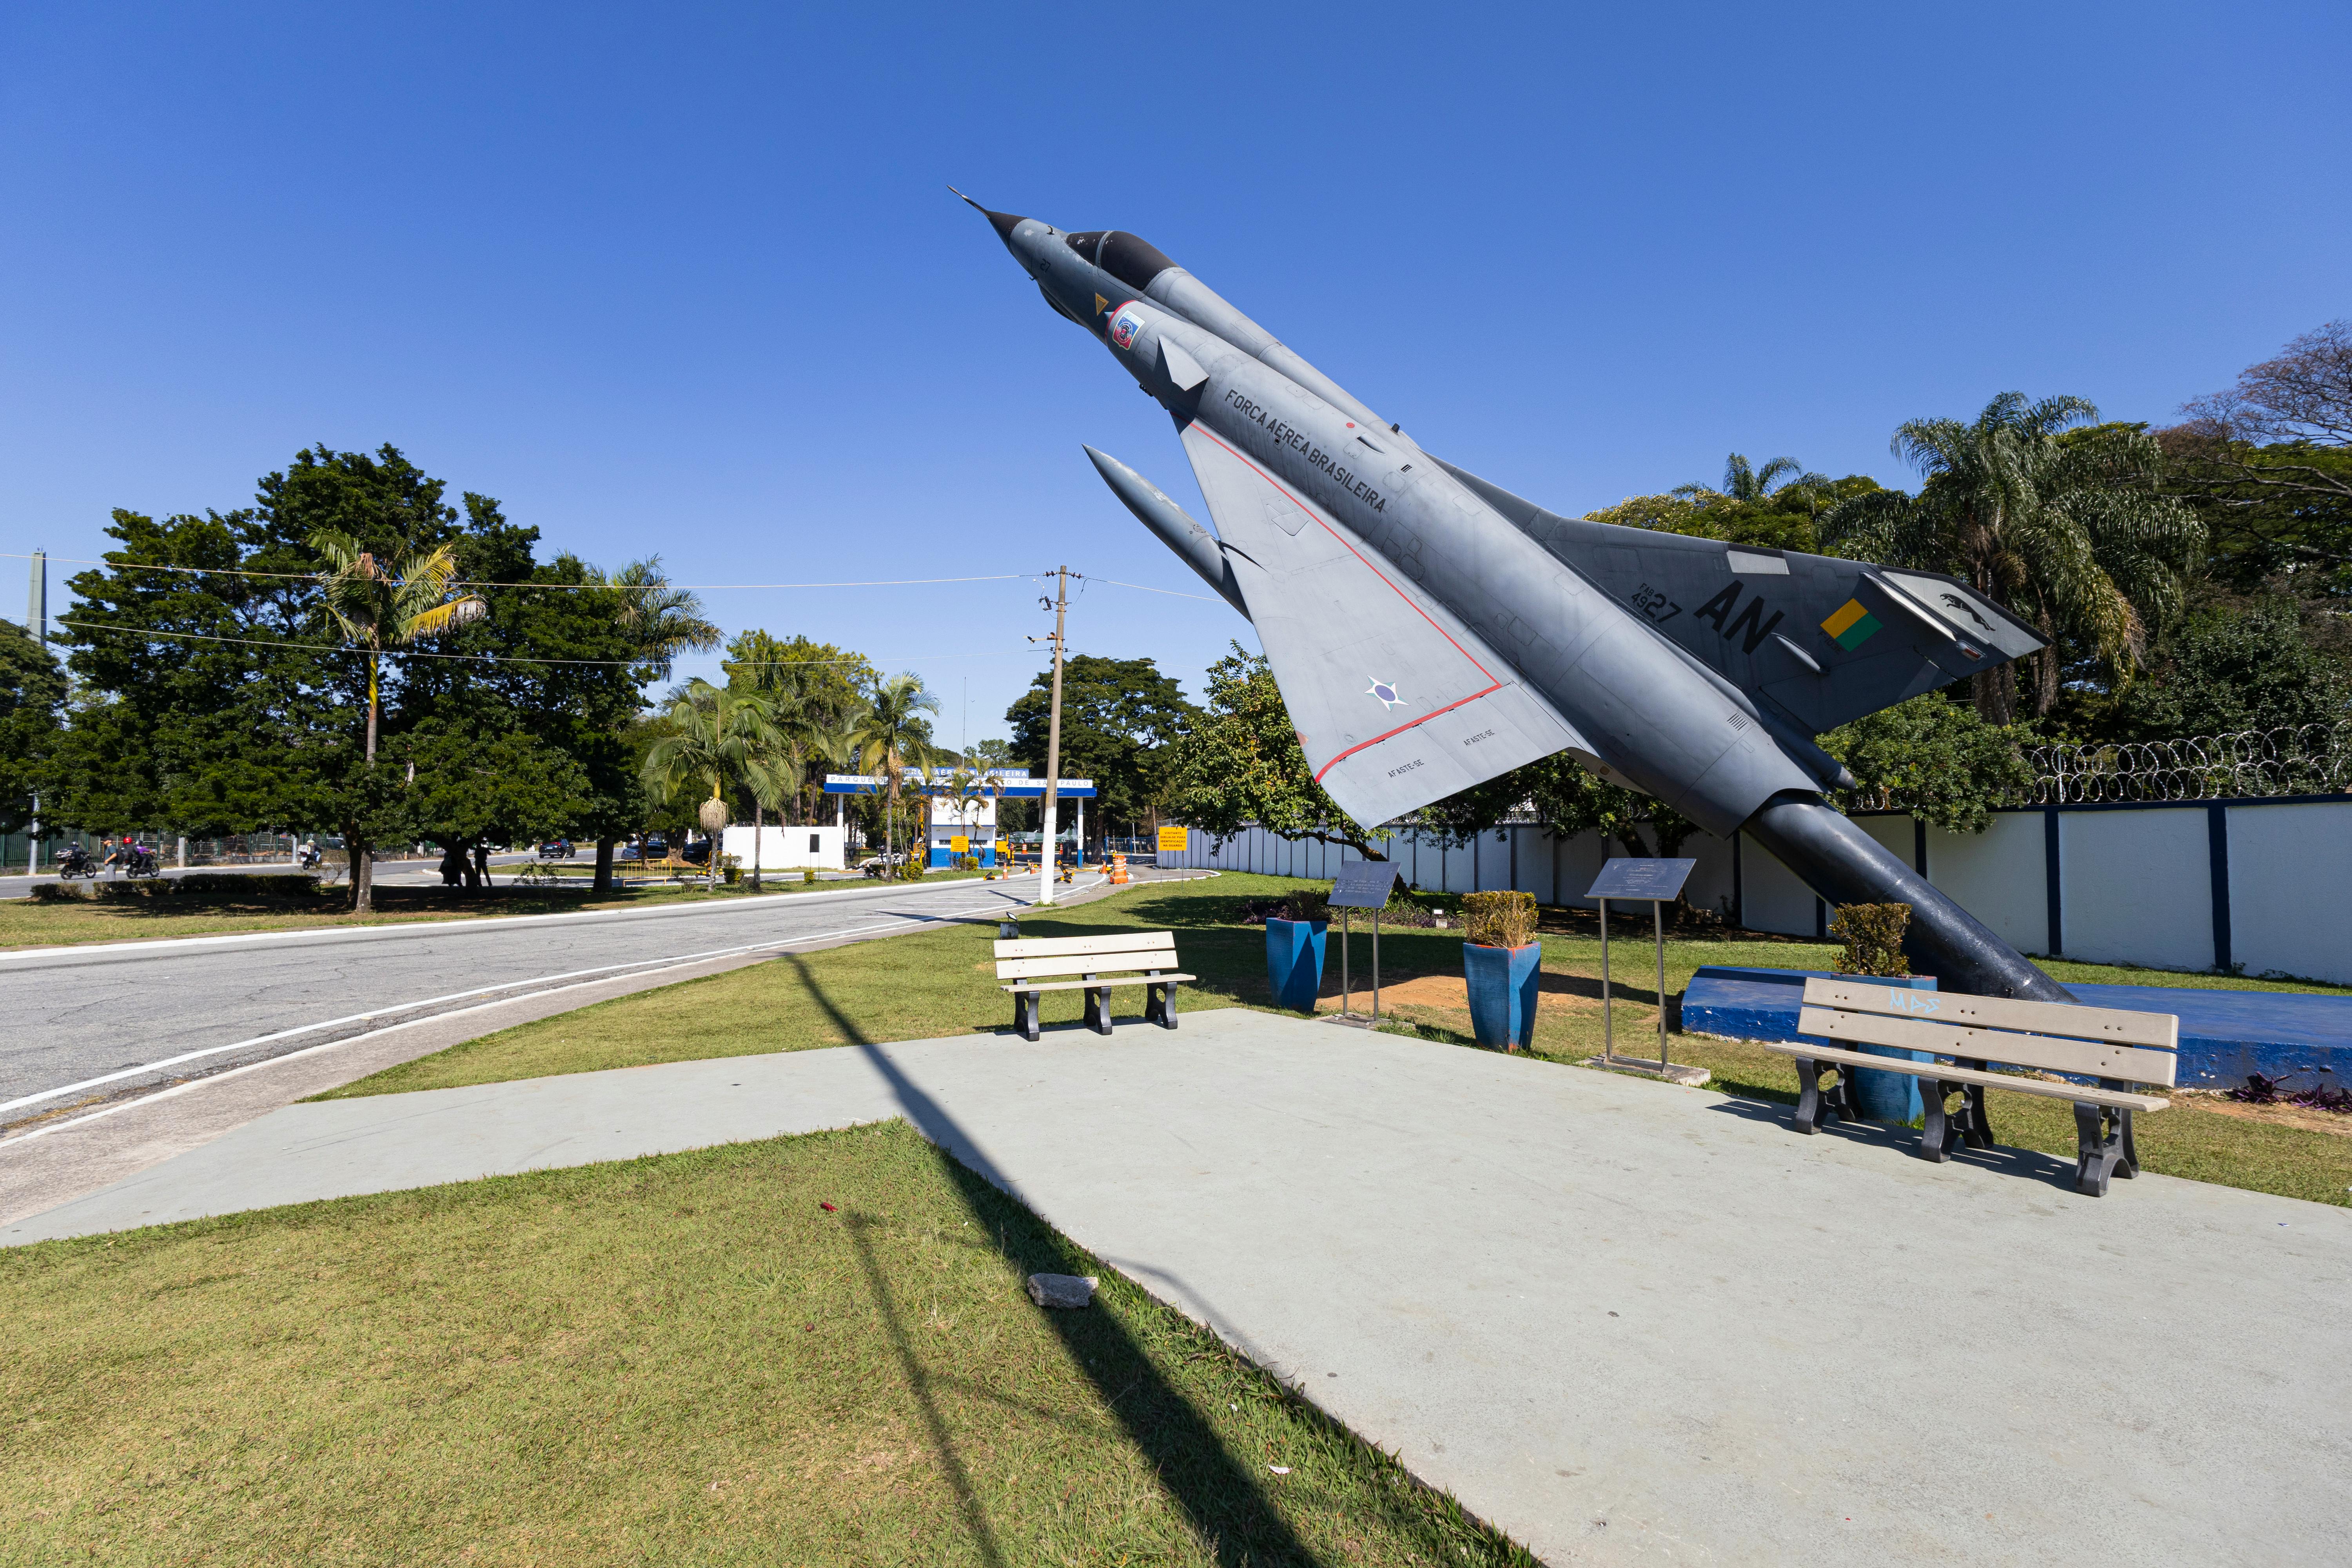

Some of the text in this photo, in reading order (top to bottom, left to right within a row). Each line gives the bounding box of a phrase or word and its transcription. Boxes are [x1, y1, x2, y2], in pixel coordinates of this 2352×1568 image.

[1040, 258, 1051, 272] 27
[1308, 448, 1386, 513] BRASILEIRA
[1639, 583, 1655, 596] FAB
[1693, 579, 1785, 655] AN
[1463, 729, 1495, 746] AFASTE-SE
[1388, 759, 1424, 778] AFASTE-SE
